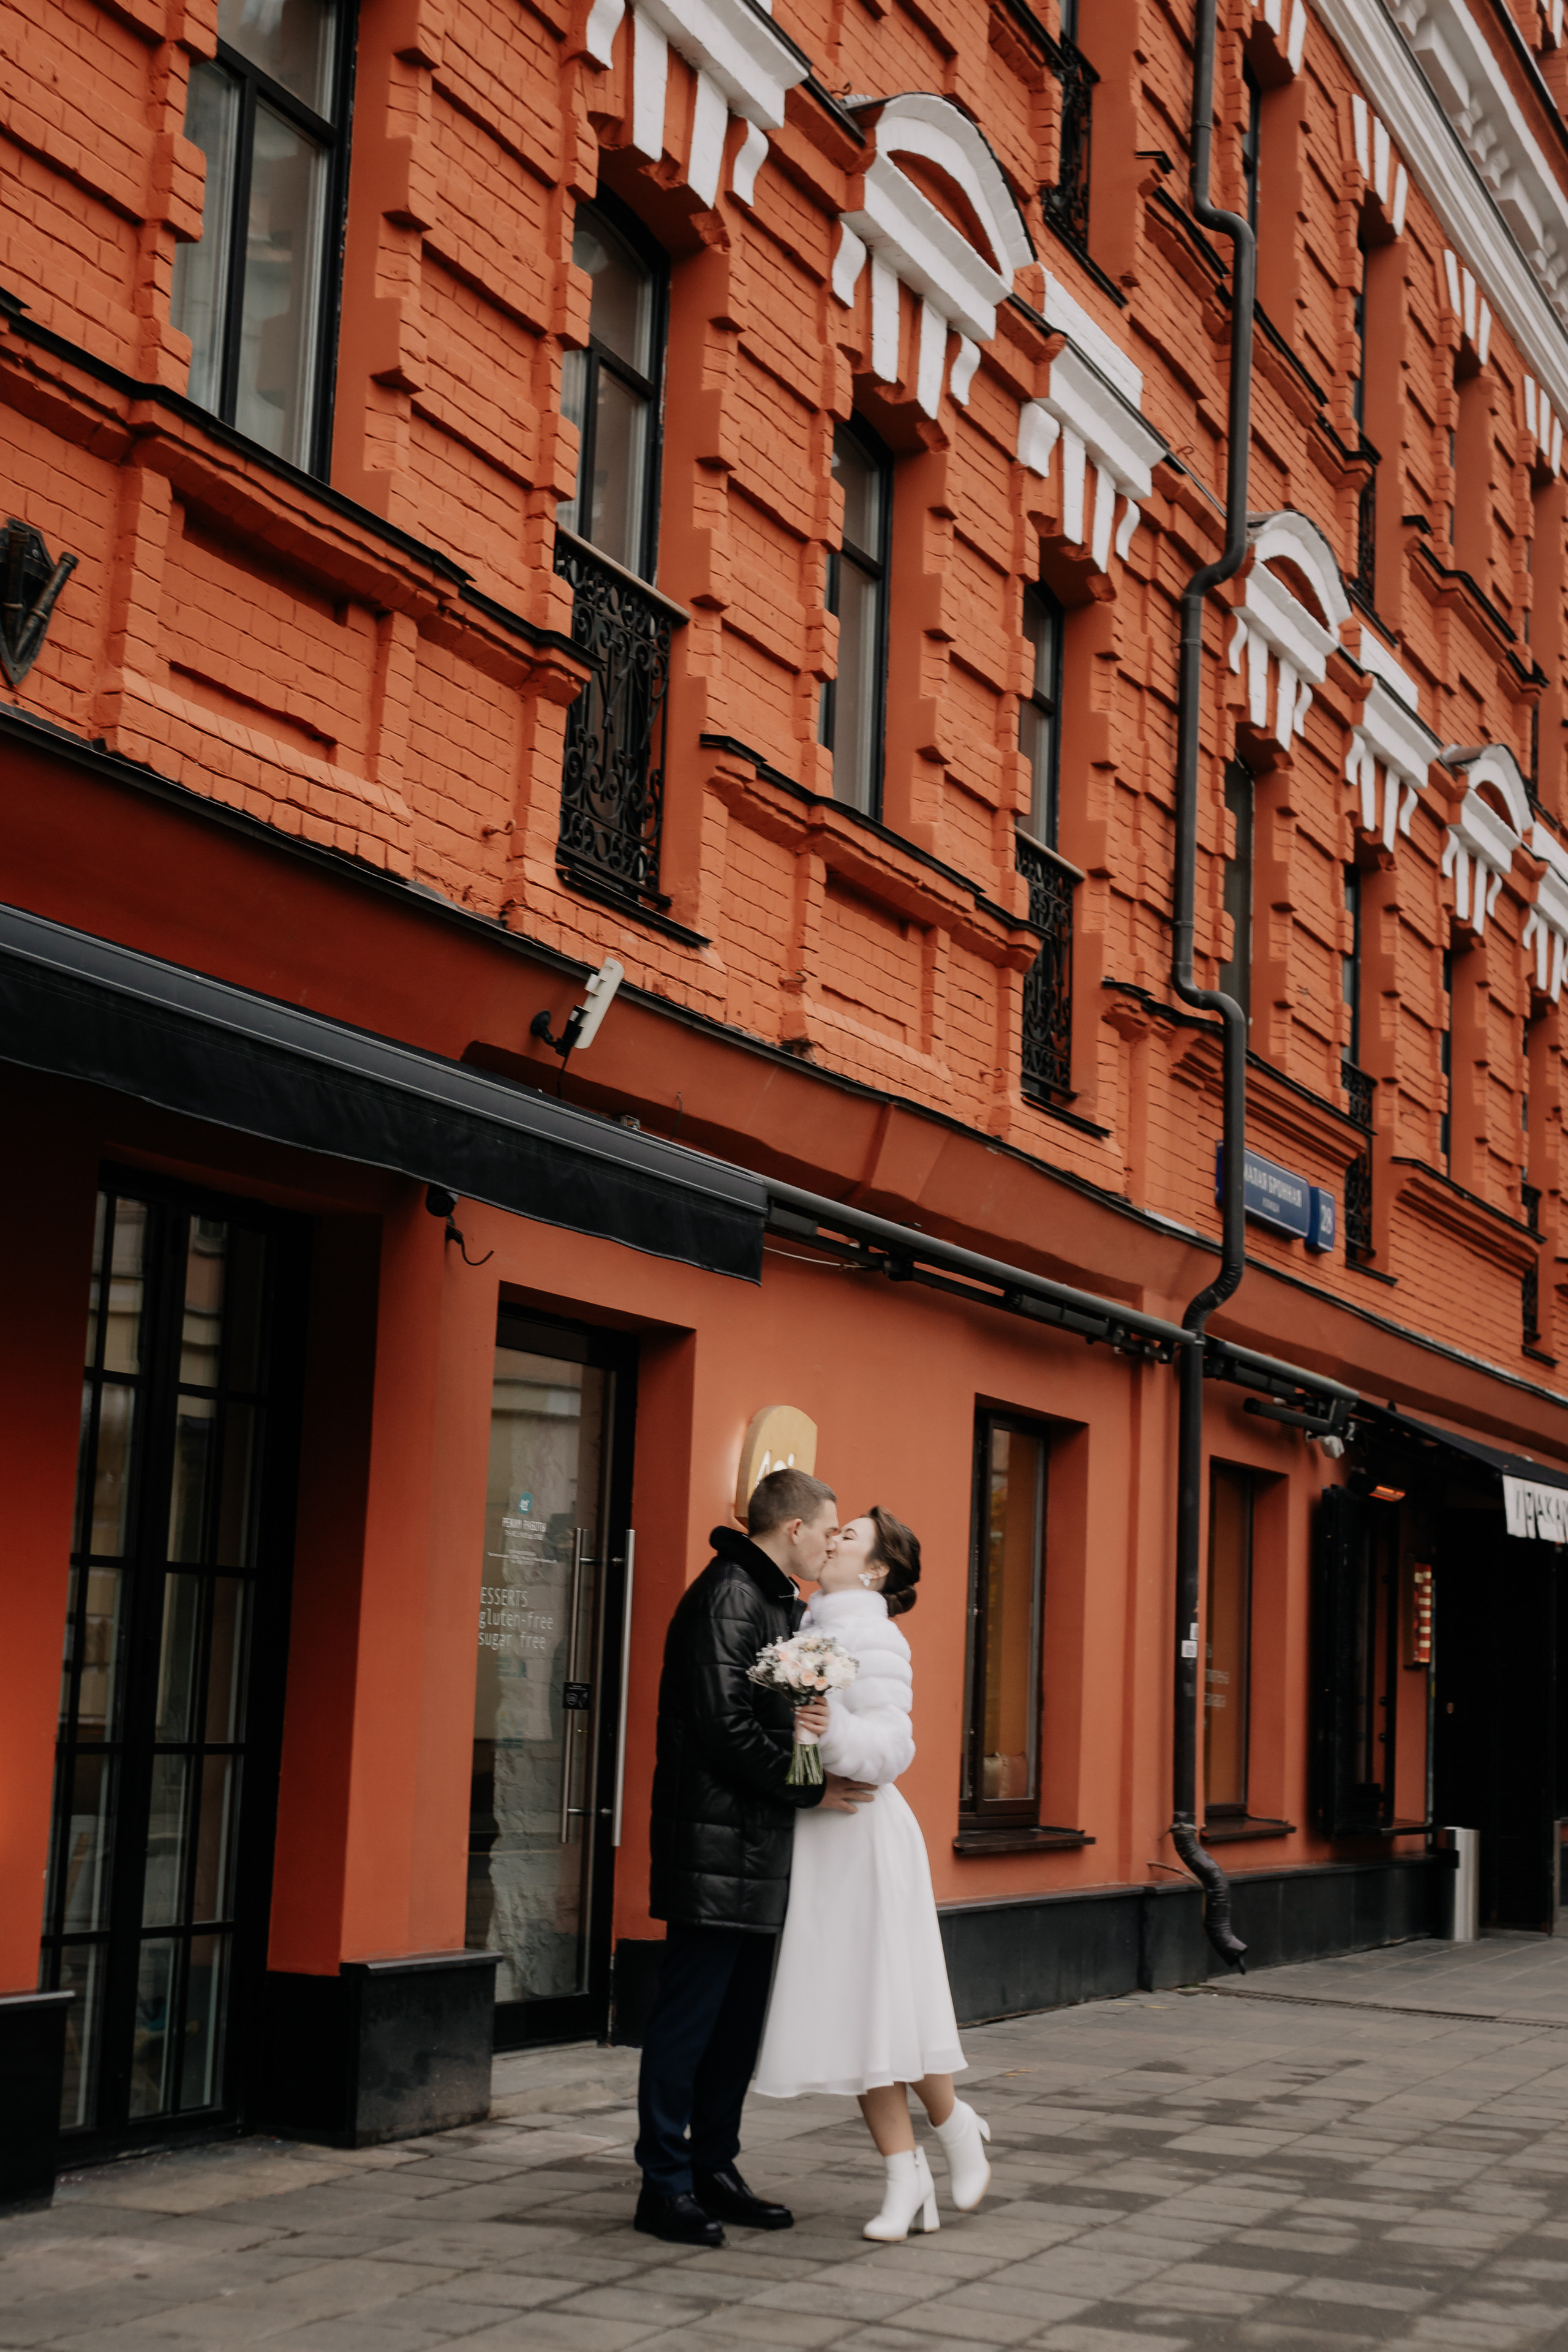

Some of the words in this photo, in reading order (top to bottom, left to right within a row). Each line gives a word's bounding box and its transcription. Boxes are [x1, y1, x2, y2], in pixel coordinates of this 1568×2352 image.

[502, 1517, 522, 1529] РЕЖИМ
[522, 1520, 547, 1532] РАБОТЫ
[480, 1586, 529, 1608] ESSERTS
[478, 1608, 554, 1630] gluten-free
[478, 1632, 513, 1651] sugar
[519, 1631, 546, 1649] free
